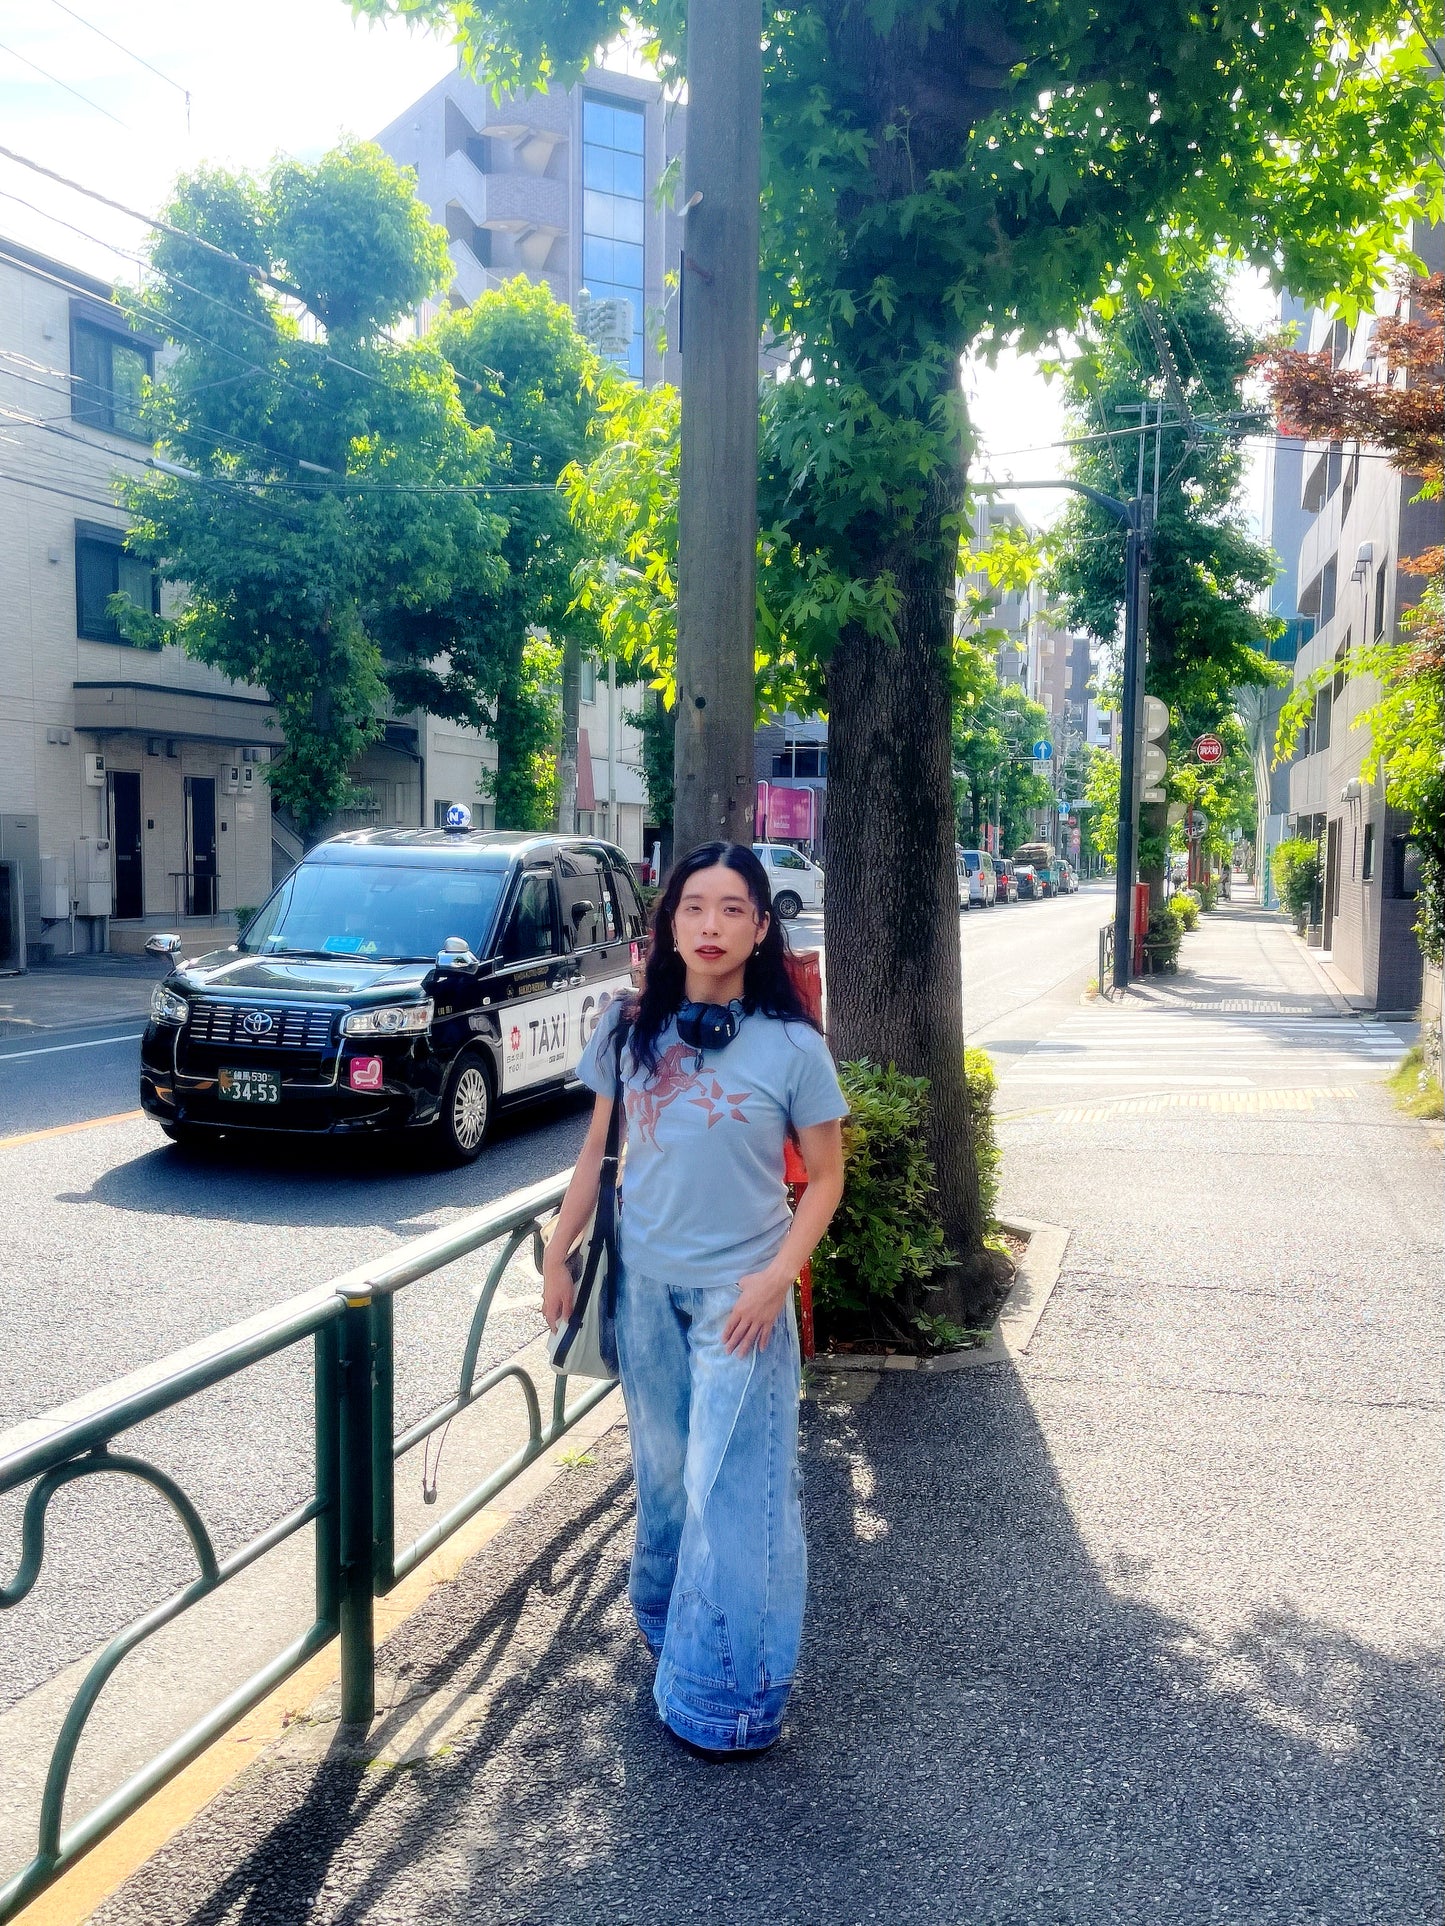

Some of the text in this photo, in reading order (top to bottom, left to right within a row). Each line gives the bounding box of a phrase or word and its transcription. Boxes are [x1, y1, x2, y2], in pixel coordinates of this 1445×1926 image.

[529, 1013, 566, 1056] TAXI
[251, 1071, 268, 1082] 530
[232, 1082, 278, 1102] 34-53
